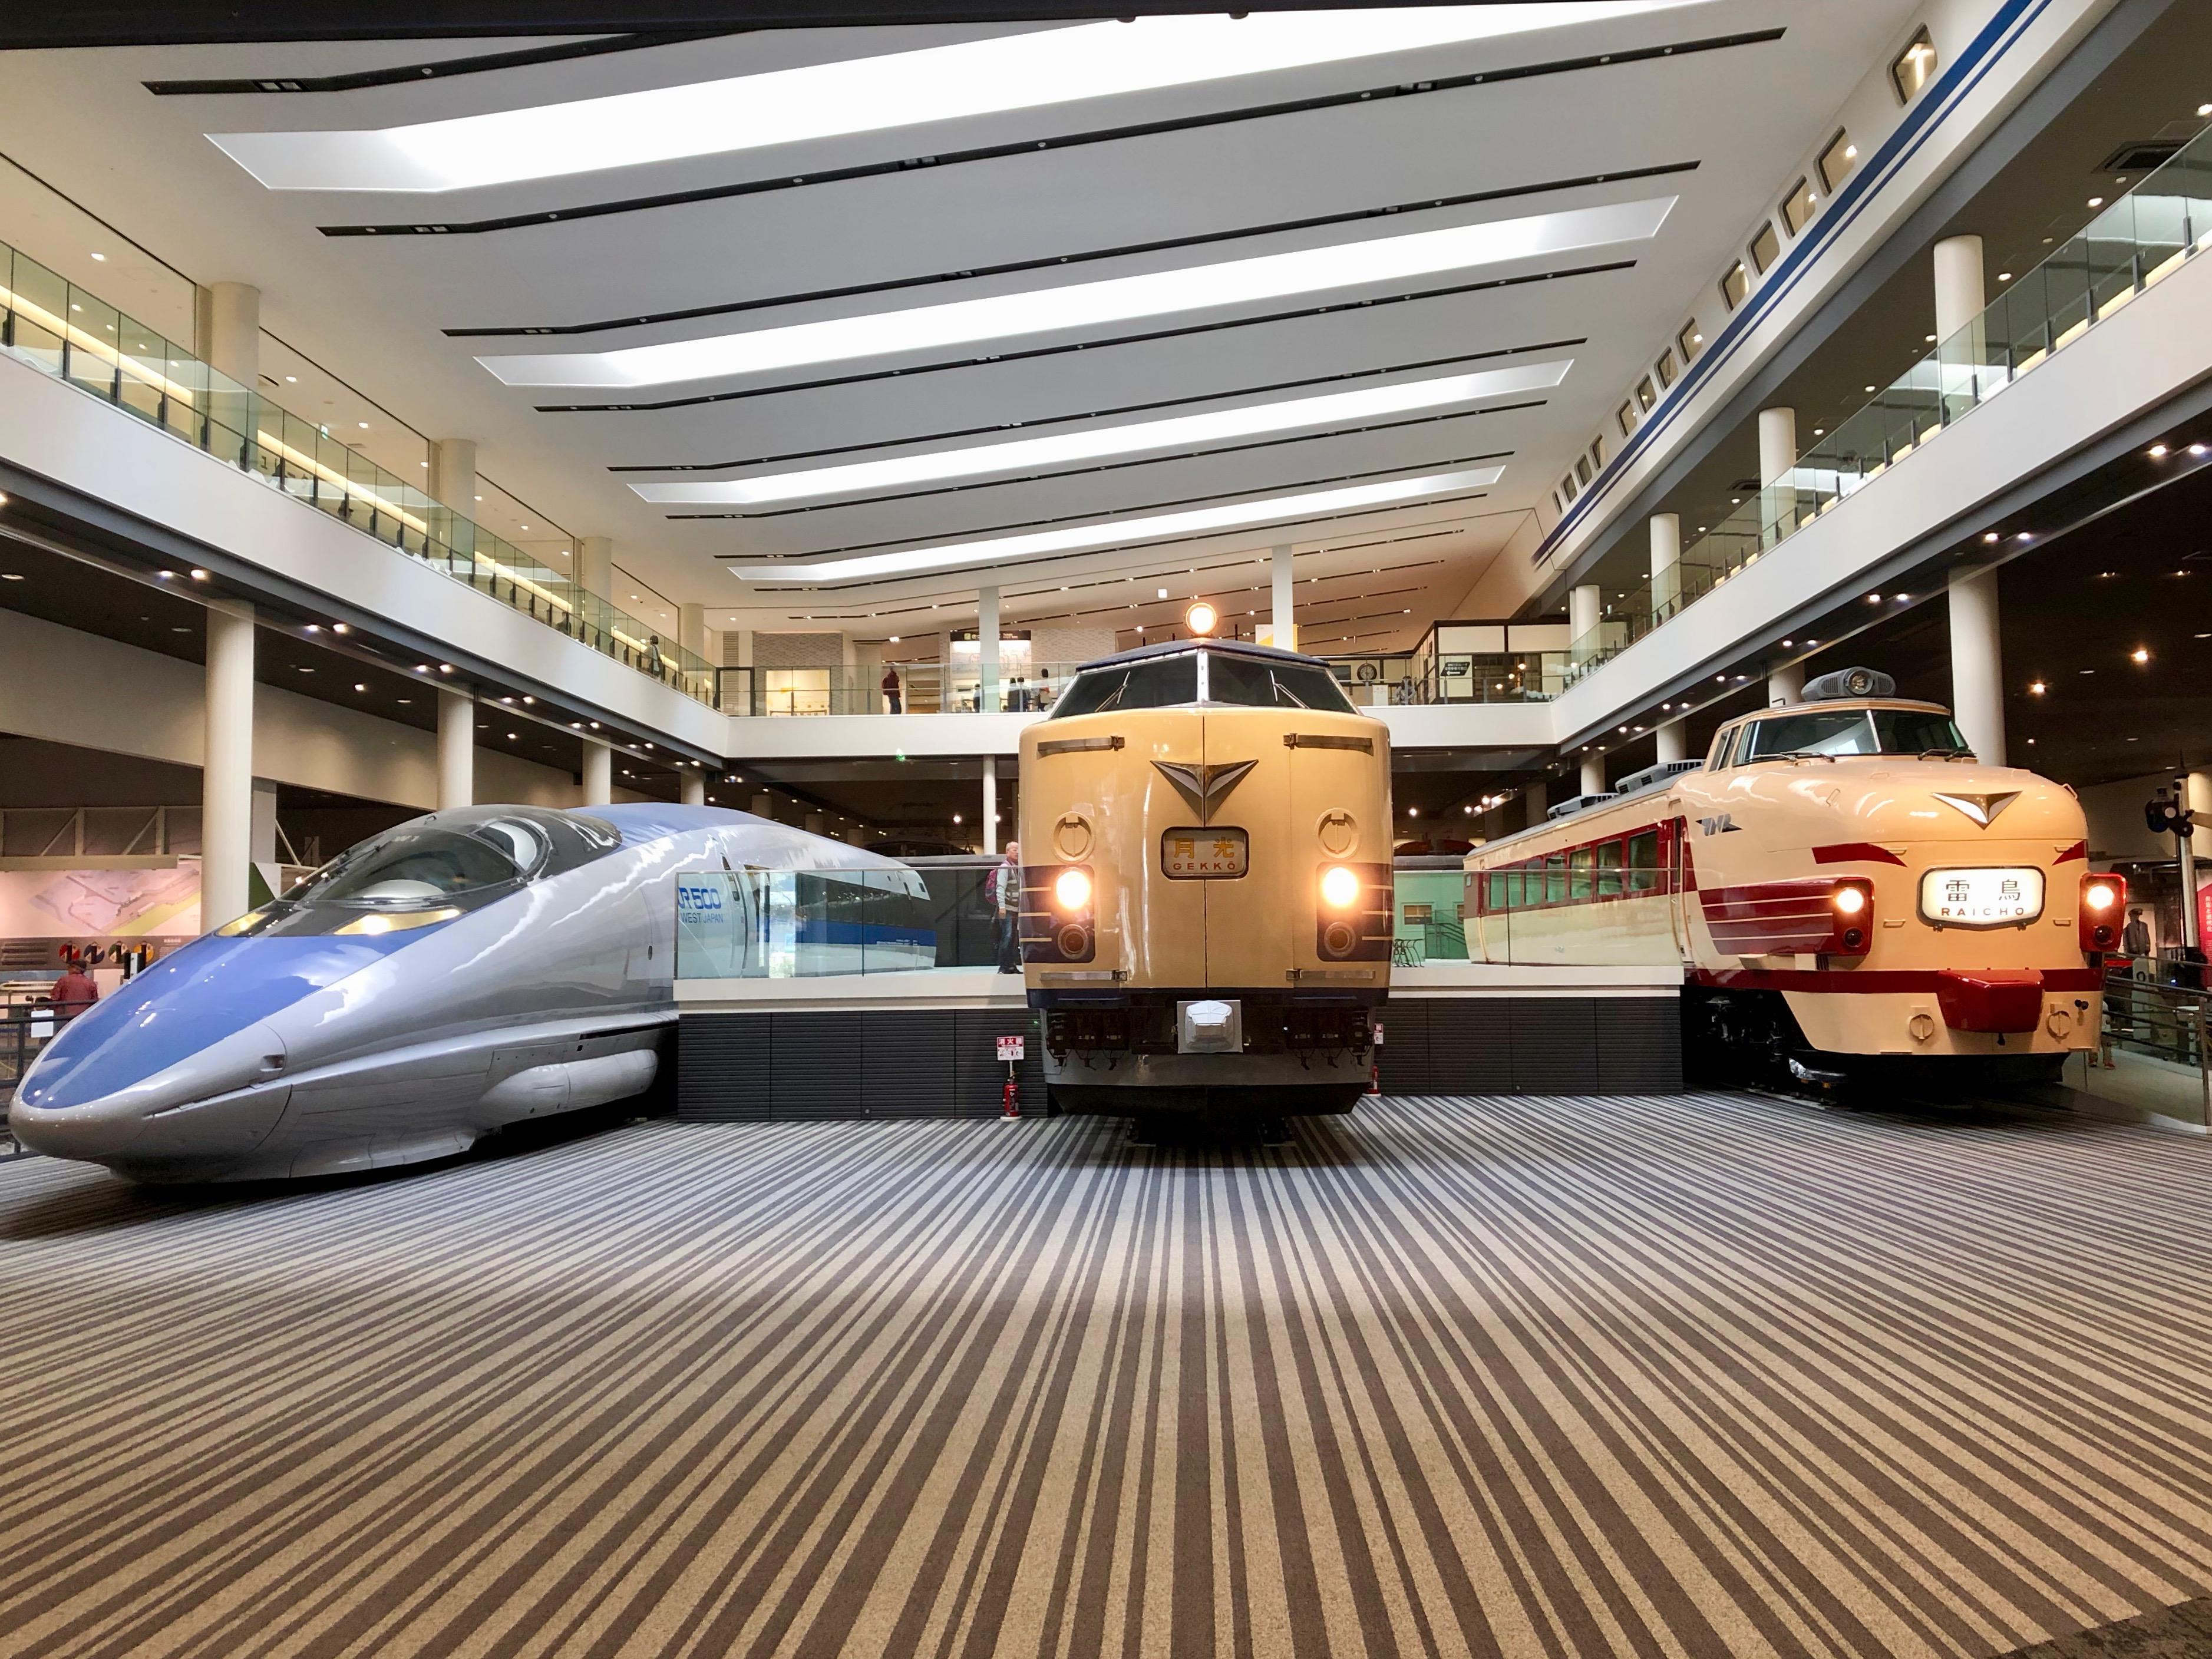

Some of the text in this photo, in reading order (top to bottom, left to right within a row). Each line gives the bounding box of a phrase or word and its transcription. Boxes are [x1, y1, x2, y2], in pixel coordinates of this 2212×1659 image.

[1173, 837, 1234, 859] 月光
[1946, 879, 2020, 901] 雷鳥
[680, 913, 724, 924] WEST JAPAN
[1942, 907, 2024, 916] RAICHO
